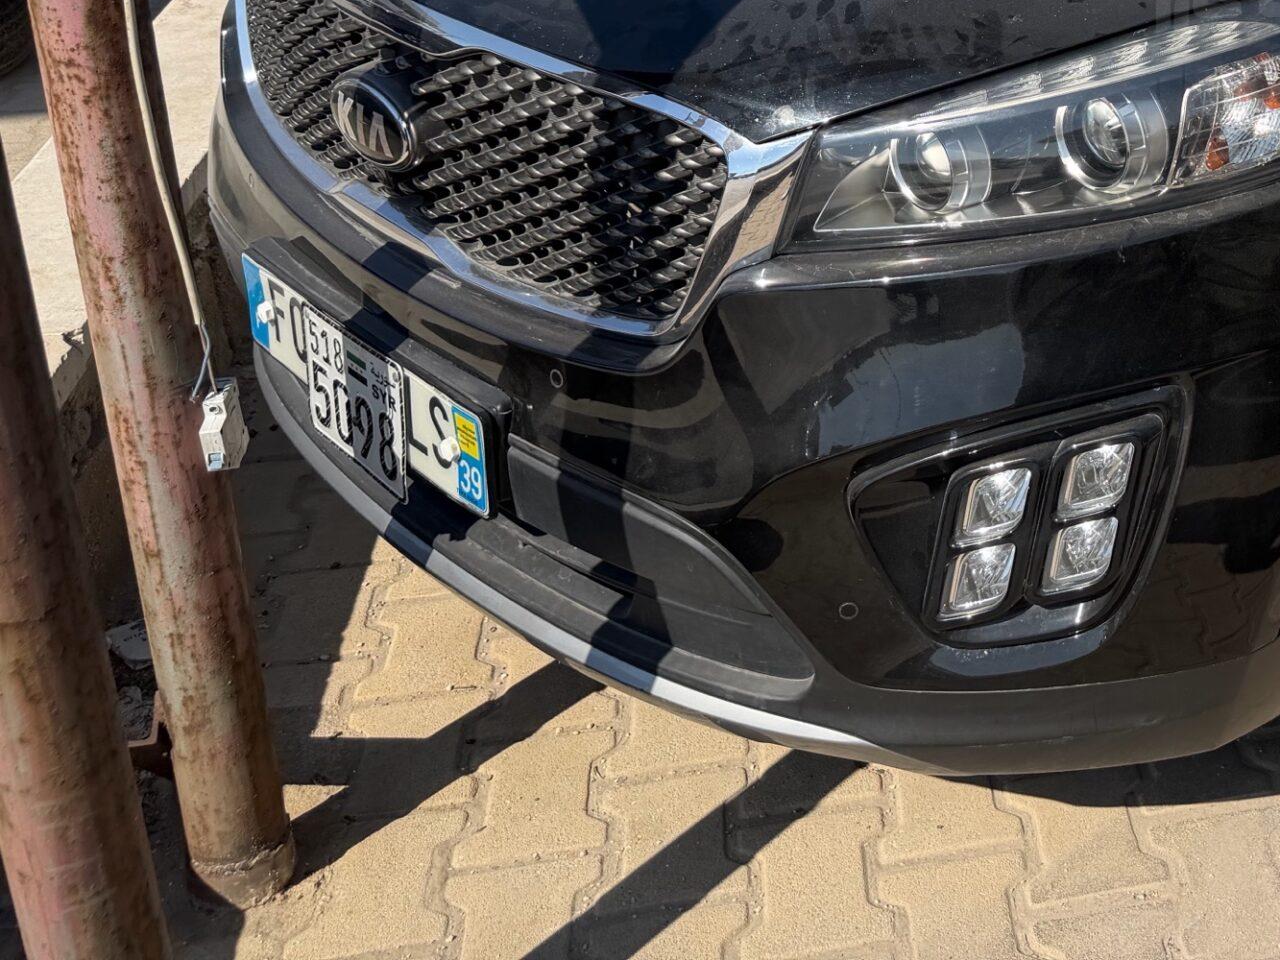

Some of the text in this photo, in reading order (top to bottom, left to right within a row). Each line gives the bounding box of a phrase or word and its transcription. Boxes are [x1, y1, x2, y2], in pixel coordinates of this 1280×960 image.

[337, 90, 394, 159] KIA
[309, 319, 343, 374] 518
[313, 360, 397, 481] 5098
[371, 384, 397, 412] SYR
[460, 459, 483, 501] 39
